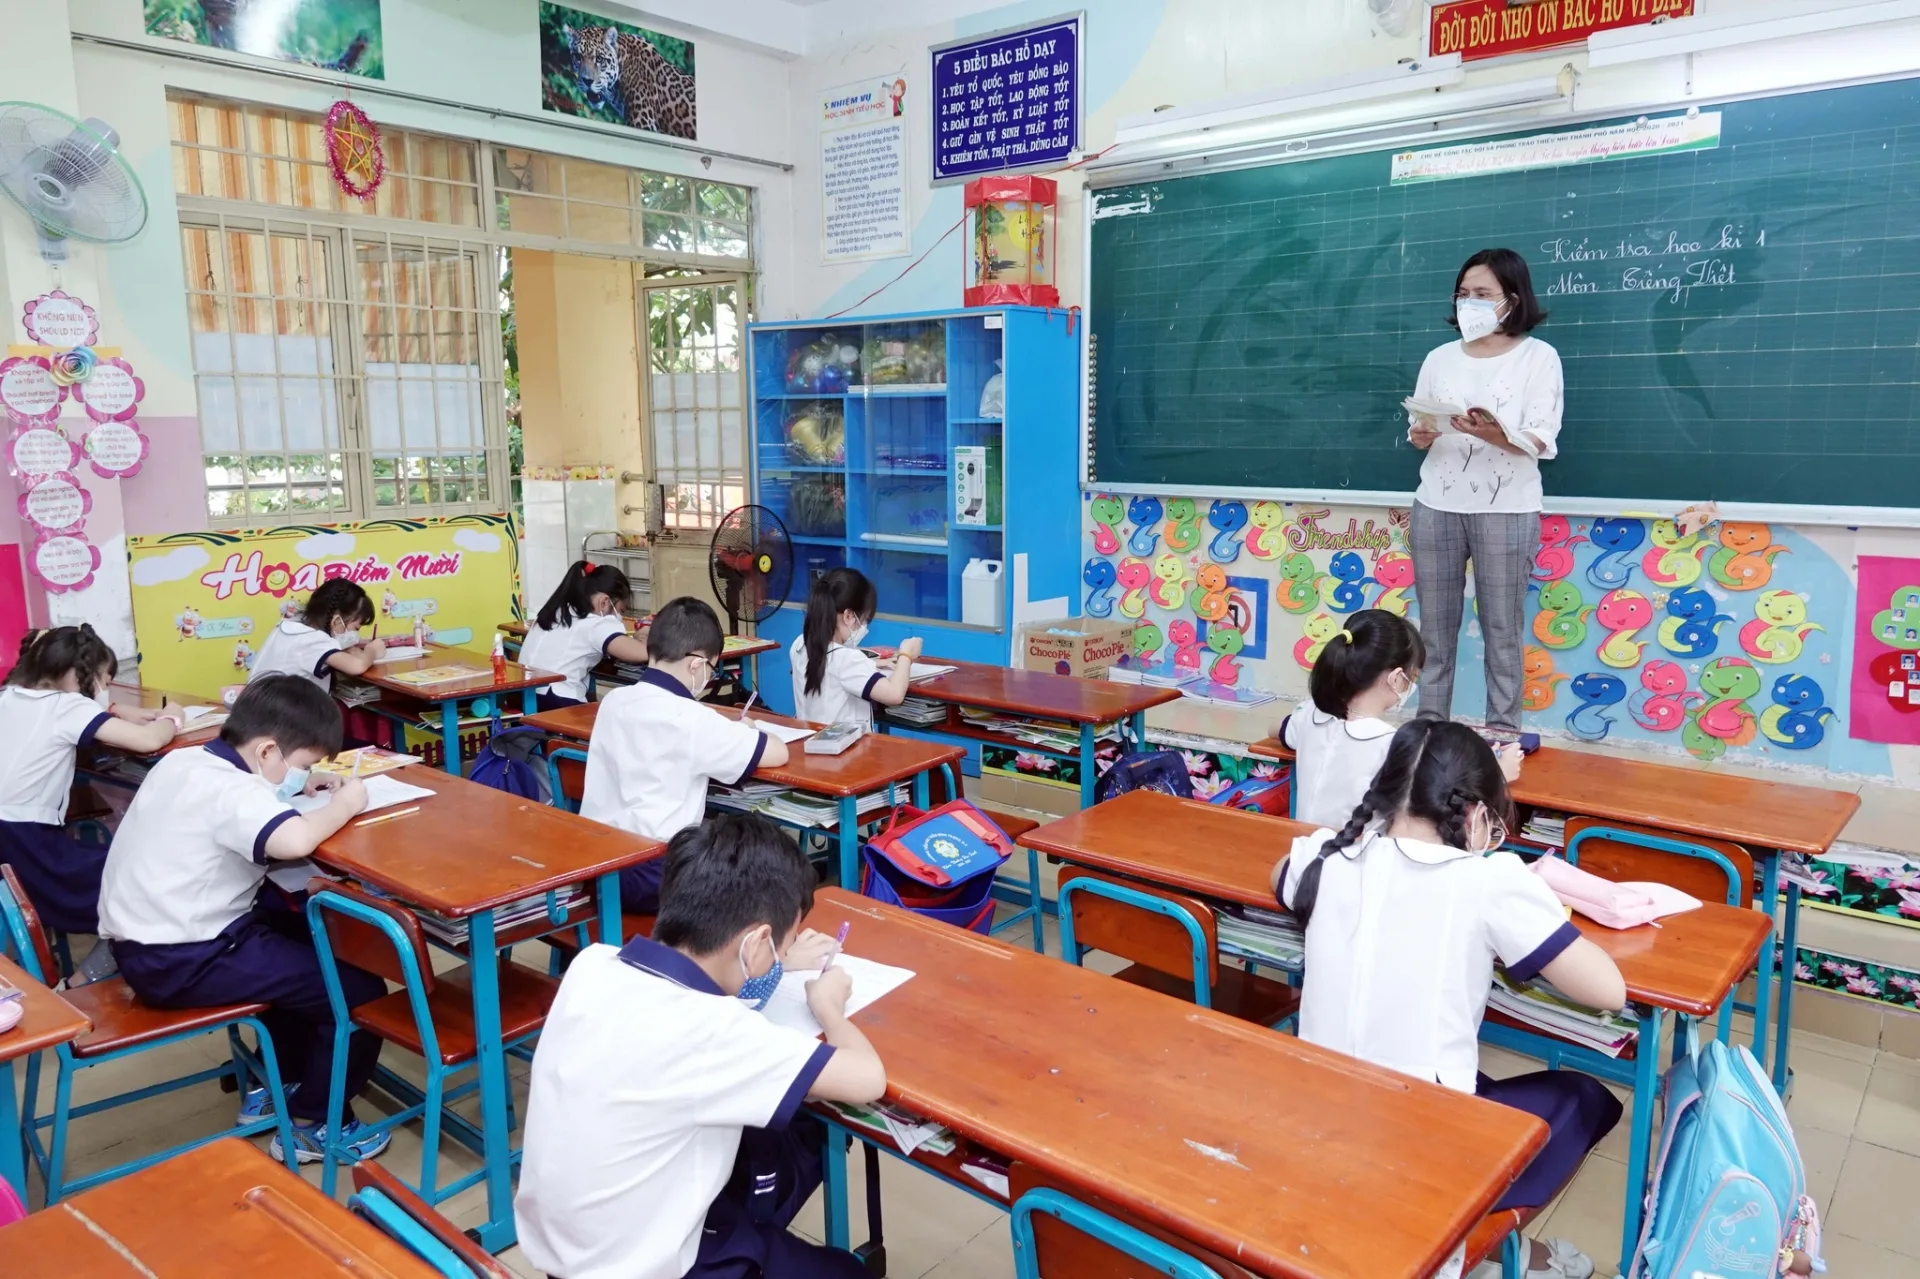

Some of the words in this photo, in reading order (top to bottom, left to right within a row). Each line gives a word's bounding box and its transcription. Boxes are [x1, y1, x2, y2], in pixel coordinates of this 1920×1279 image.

[1440, 11, 1466, 53] ĐỜI
[1470, 4, 1497, 48] ĐỜI
[953, 61, 961, 75] 5
[963, 50, 988, 73] ĐIỀU
[991, 48, 1013, 67] BÁC
[1015, 38, 1031, 62] HỒ
[1033, 39, 1057, 59] DẠY
[949, 83, 965, 97] YÊU
[967, 75, 978, 93] TỔ
[1008, 70, 1024, 85] YÊU
[1028, 63, 1049, 81] ĐỒNG
[1053, 60, 1069, 76] BÀO
[949, 101, 966, 116] HỌC
[970, 96, 984, 113] TẬP
[1009, 90, 1024, 103] LAO
[1028, 84, 1049, 101] ĐỘNG
[1054, 76, 1070, 94] TỐT
[949, 116, 970, 131] ĐOÀN
[973, 110, 989, 127] KẾT
[1013, 104, 1025, 120] KỶ
[1028, 101, 1049, 118] LUẬT
[1054, 94, 1070, 112] TỐT
[949, 134, 964, 148] GIỮ
[968, 130, 982, 145] GÌN
[986, 127, 997, 143] VỆ
[1001, 126, 1020, 139] SINH
[1025, 120, 1046, 136] THẬT
[1053, 113, 1070, 130] TỐT
[949, 150, 973, 165] KHIÊM
[991, 143, 1011, 159] THẬT
[1030, 138, 1051, 152] DŨNG
[1052, 132, 1069, 148] CẢM
[1540, 238, 1608, 263] Kiểm
[1615, 239, 1652, 259] tra
[1662, 230, 1702, 261] học
[1756, 229, 1765, 247] 1
[1547, 271, 1600, 296] Môn
[1622, 263, 1683, 304] Tiếng
[1686, 258, 1737, 292] Việt
[1288, 509, 1391, 561] Friendship
[396, 553, 460, 579] Mười
